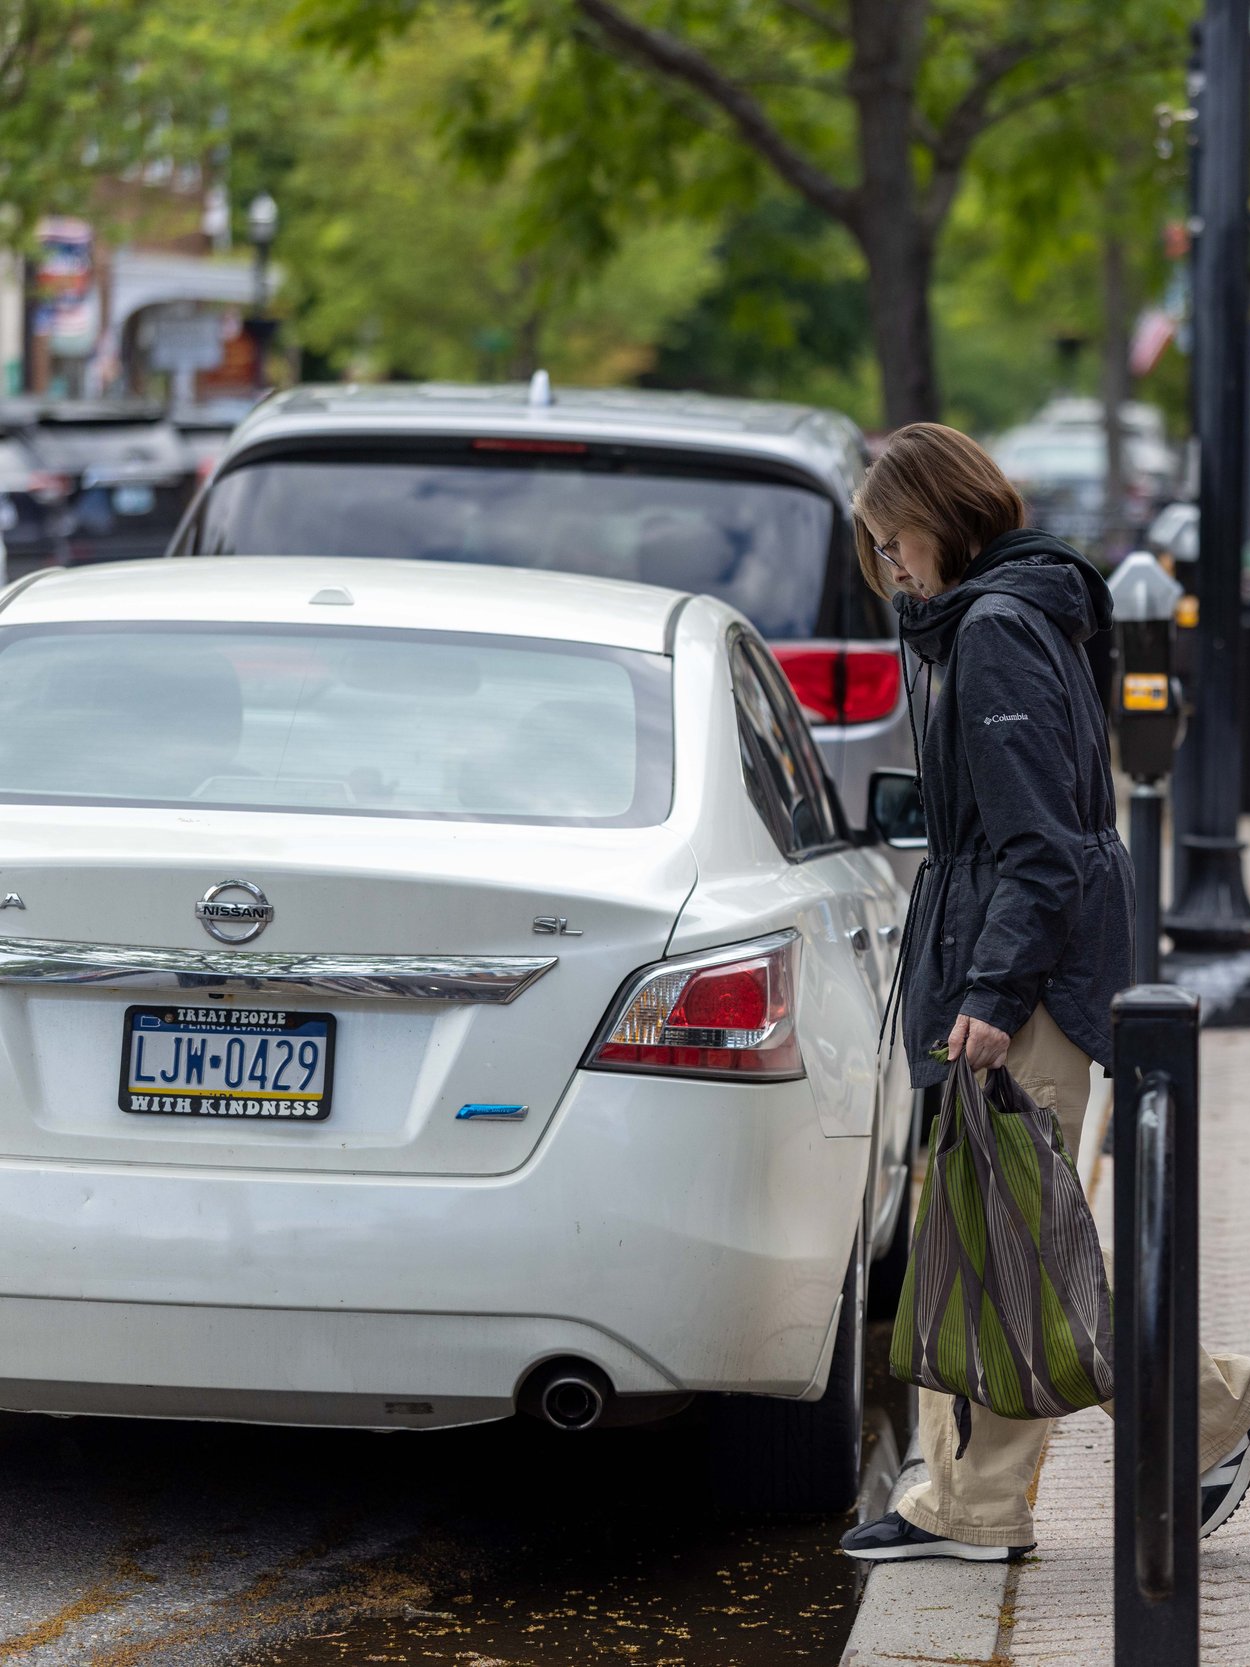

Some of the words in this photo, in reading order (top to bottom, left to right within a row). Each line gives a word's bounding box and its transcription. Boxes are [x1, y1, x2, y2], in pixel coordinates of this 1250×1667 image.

[992, 712, 1029, 723] Columbia
[203, 905, 265, 918] NISSAN
[533, 916, 584, 936] SL
[177, 1008, 227, 1023] TREAT
[230, 1011, 286, 1025] PEOPLE
[130, 1095, 192, 1113] WITH
[199, 1098, 319, 1117] KINDNESS
